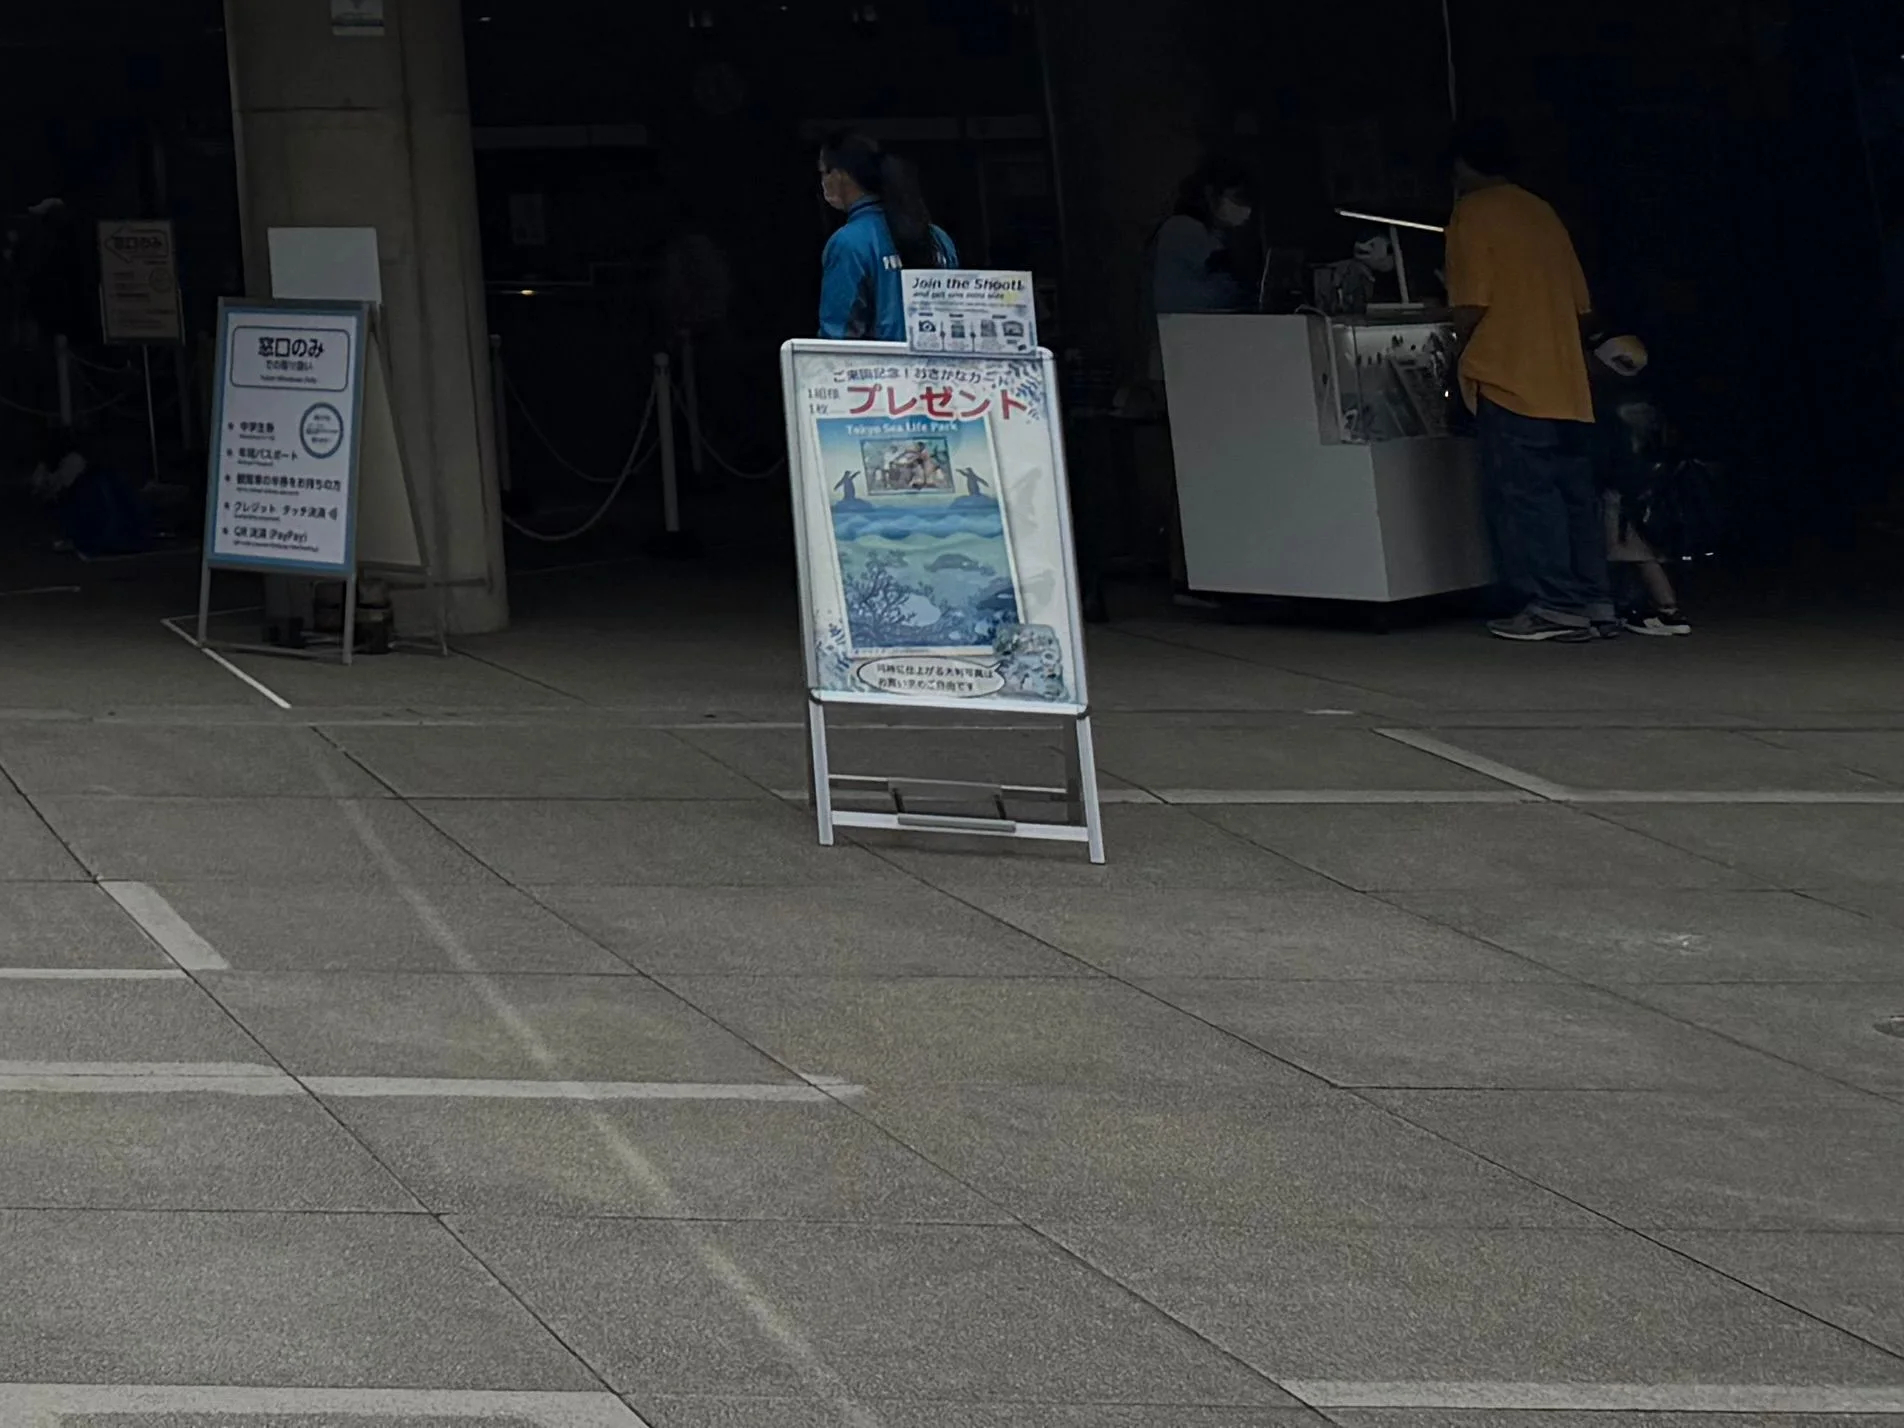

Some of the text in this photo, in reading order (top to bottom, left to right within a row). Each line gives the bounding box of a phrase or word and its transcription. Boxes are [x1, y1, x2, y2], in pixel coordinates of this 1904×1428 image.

[912, 277, 942, 290] Join
[946, 278, 970, 290] the
[257, 336, 325, 358] 窓口のみ
[846, 383, 1028, 420] プレゼント
[846, 420, 958, 435] Tokyo Sea Life Park
